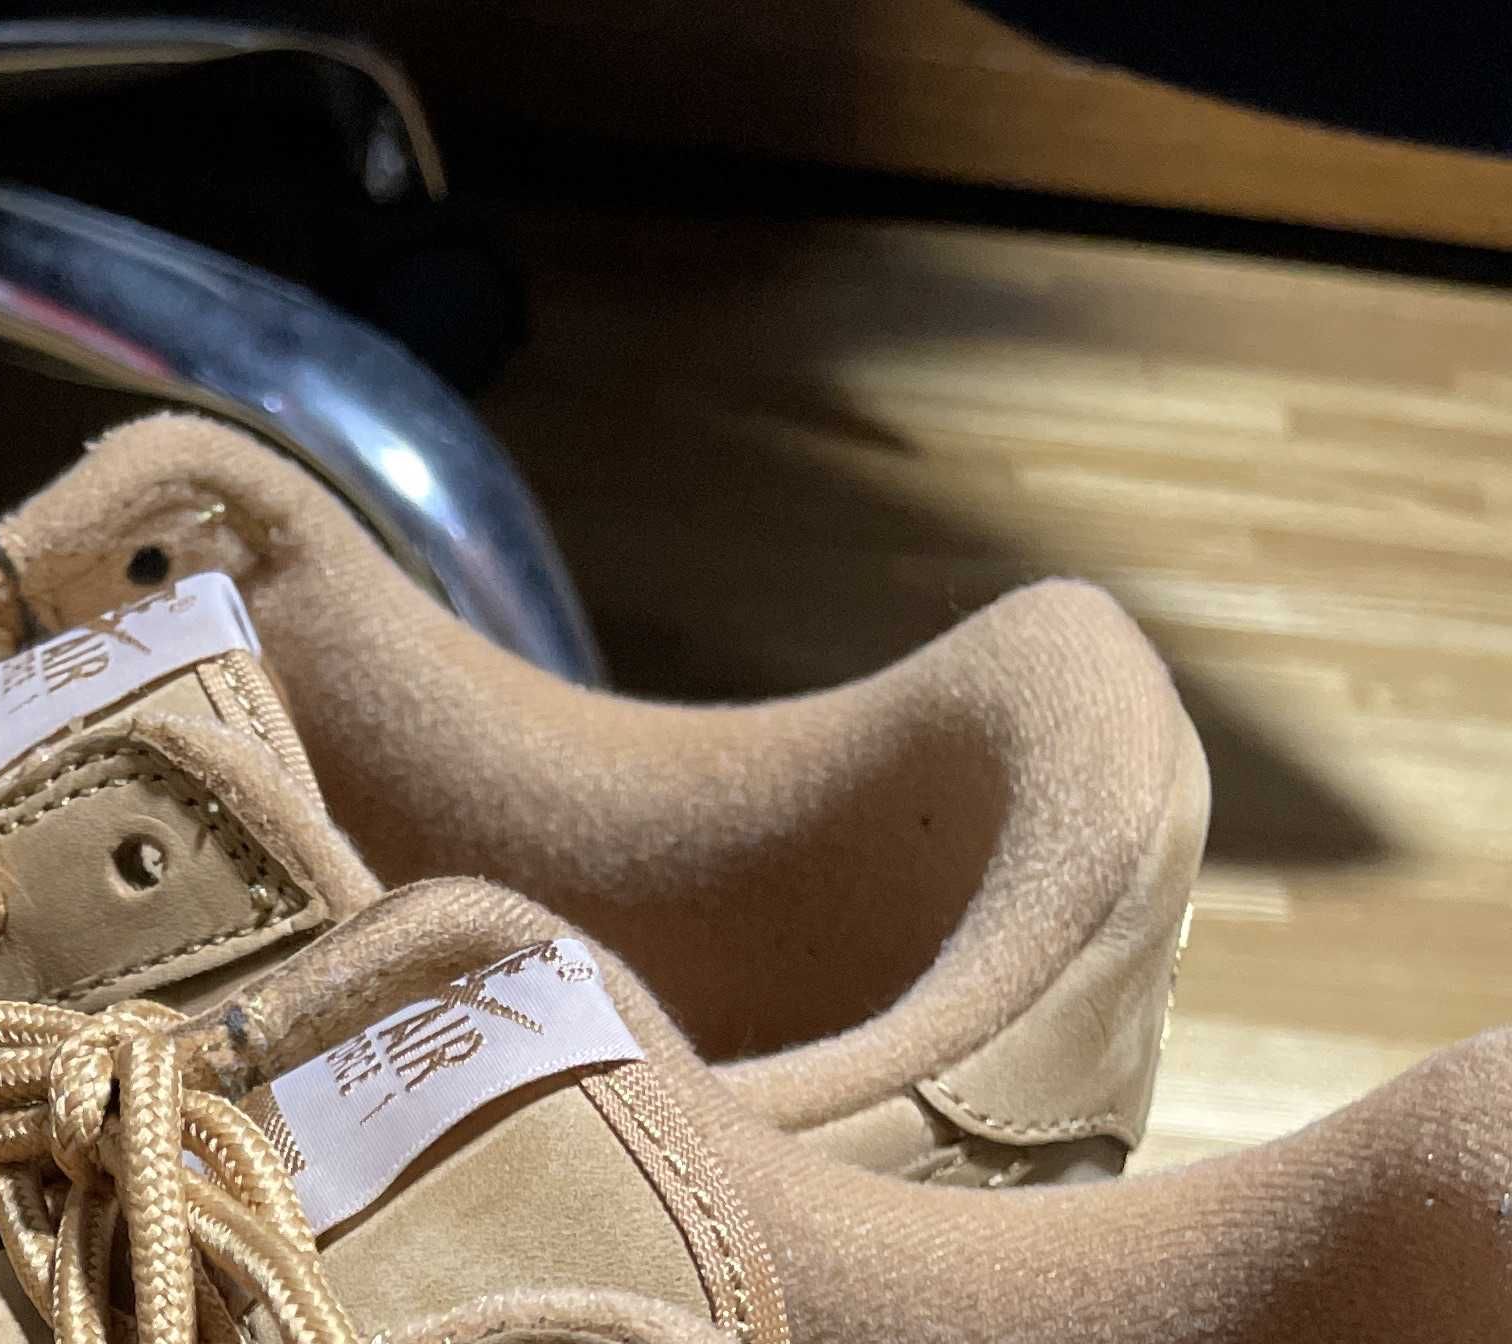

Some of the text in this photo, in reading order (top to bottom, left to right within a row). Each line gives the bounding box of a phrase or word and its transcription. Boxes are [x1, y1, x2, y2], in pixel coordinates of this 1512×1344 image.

[42, 632, 110, 694] AIR
[326, 1033, 383, 1097] ORCE
[377, 1002, 486, 1094] AIR
